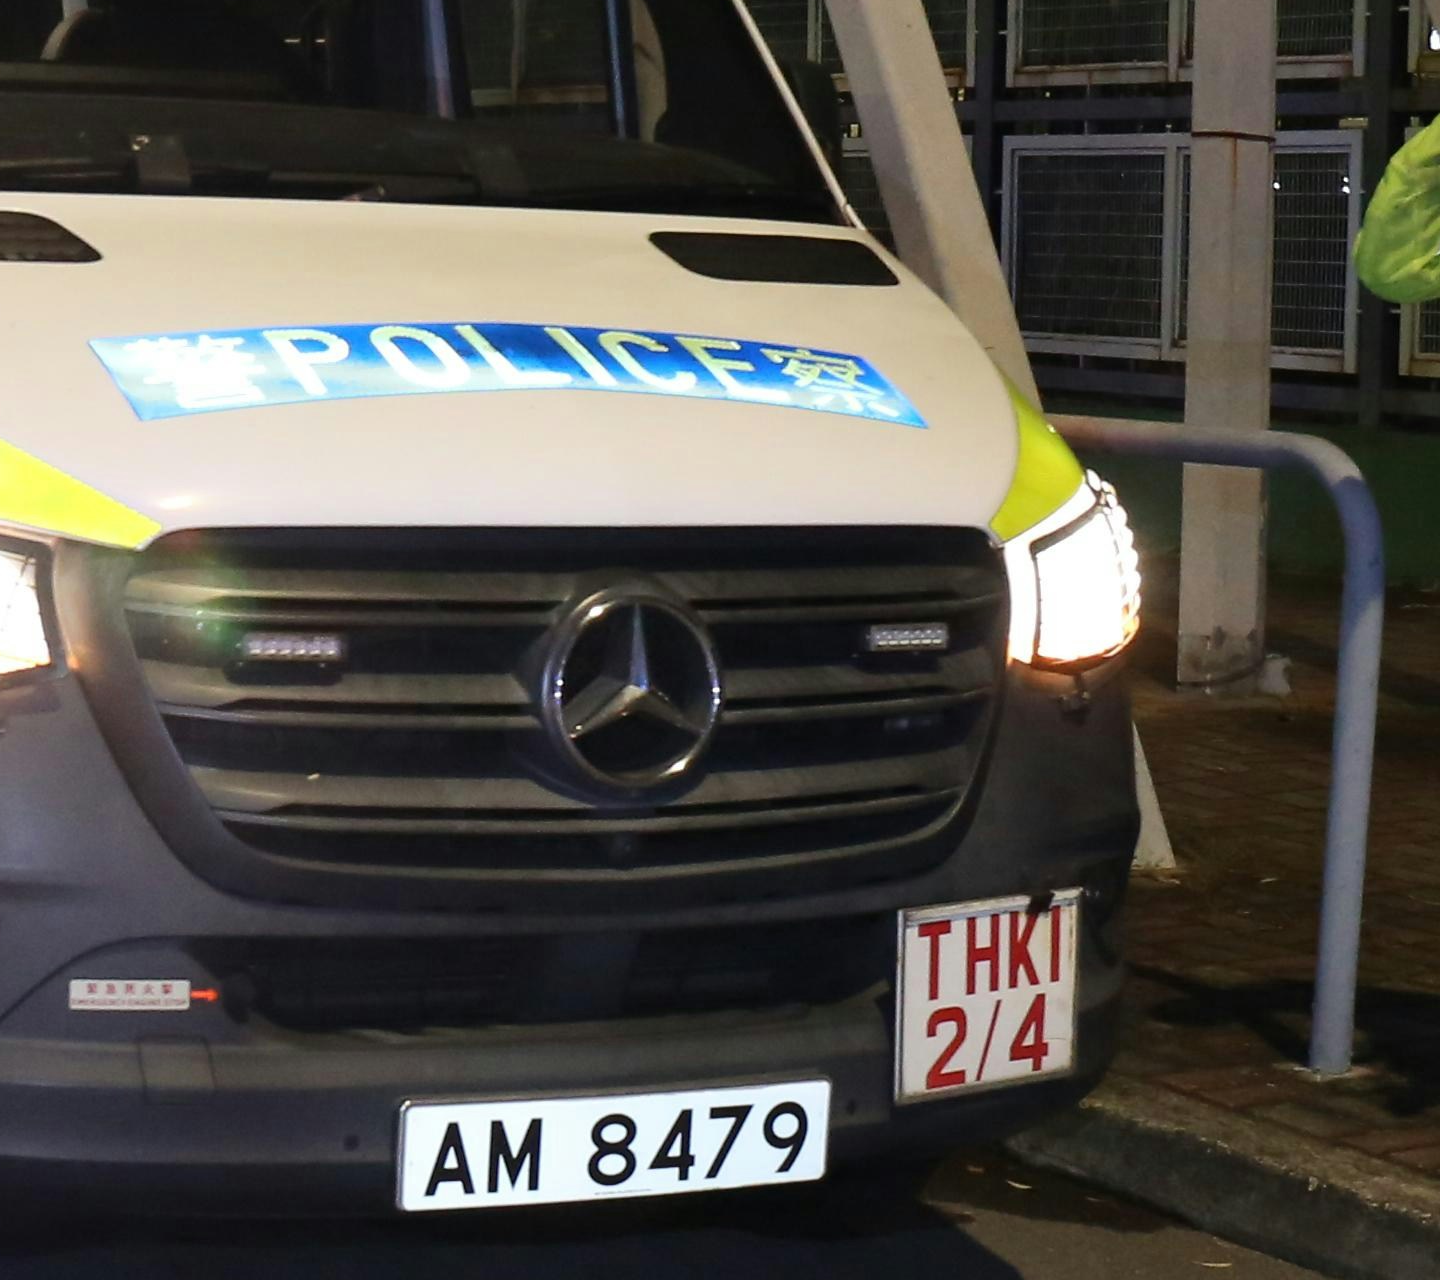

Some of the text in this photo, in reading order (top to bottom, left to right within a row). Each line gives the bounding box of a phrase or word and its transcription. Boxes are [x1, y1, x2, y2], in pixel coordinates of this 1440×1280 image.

[262, 324, 791, 401] POLICE
[926, 993, 1049, 1090] 2/4
[424, 1101, 809, 1197] AM 8479
